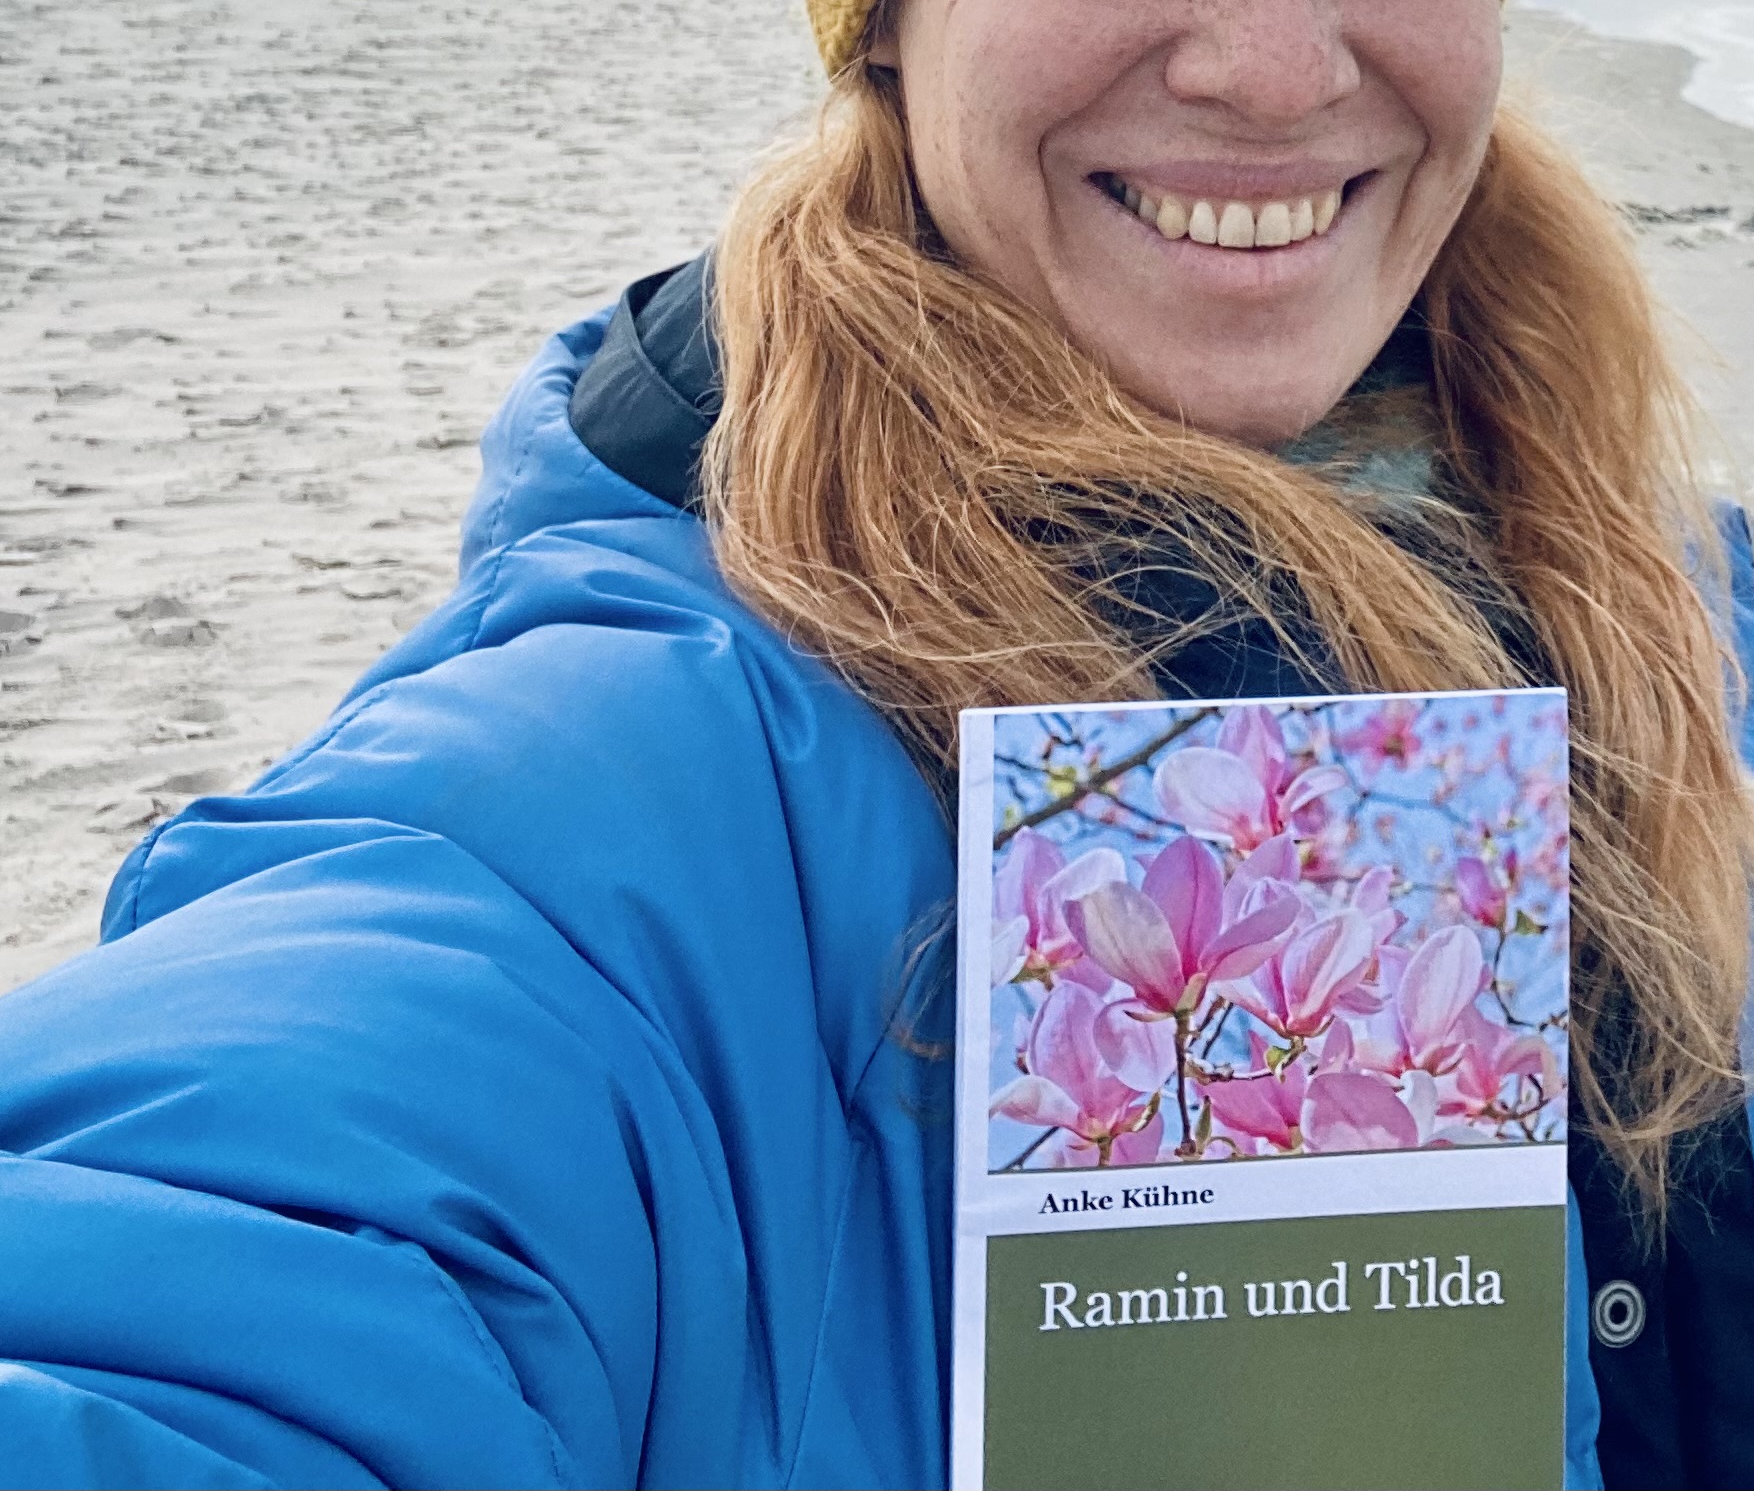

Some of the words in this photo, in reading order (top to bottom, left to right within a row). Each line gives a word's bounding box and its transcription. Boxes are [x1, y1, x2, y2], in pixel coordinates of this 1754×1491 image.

[1038, 1189, 1113, 1214] Anke
[1121, 1184, 1214, 1209] Kühne
[1038, 1270, 1228, 1331] Ramin
[1243, 1260, 1351, 1318] und
[1364, 1254, 1505, 1311] Tilda
